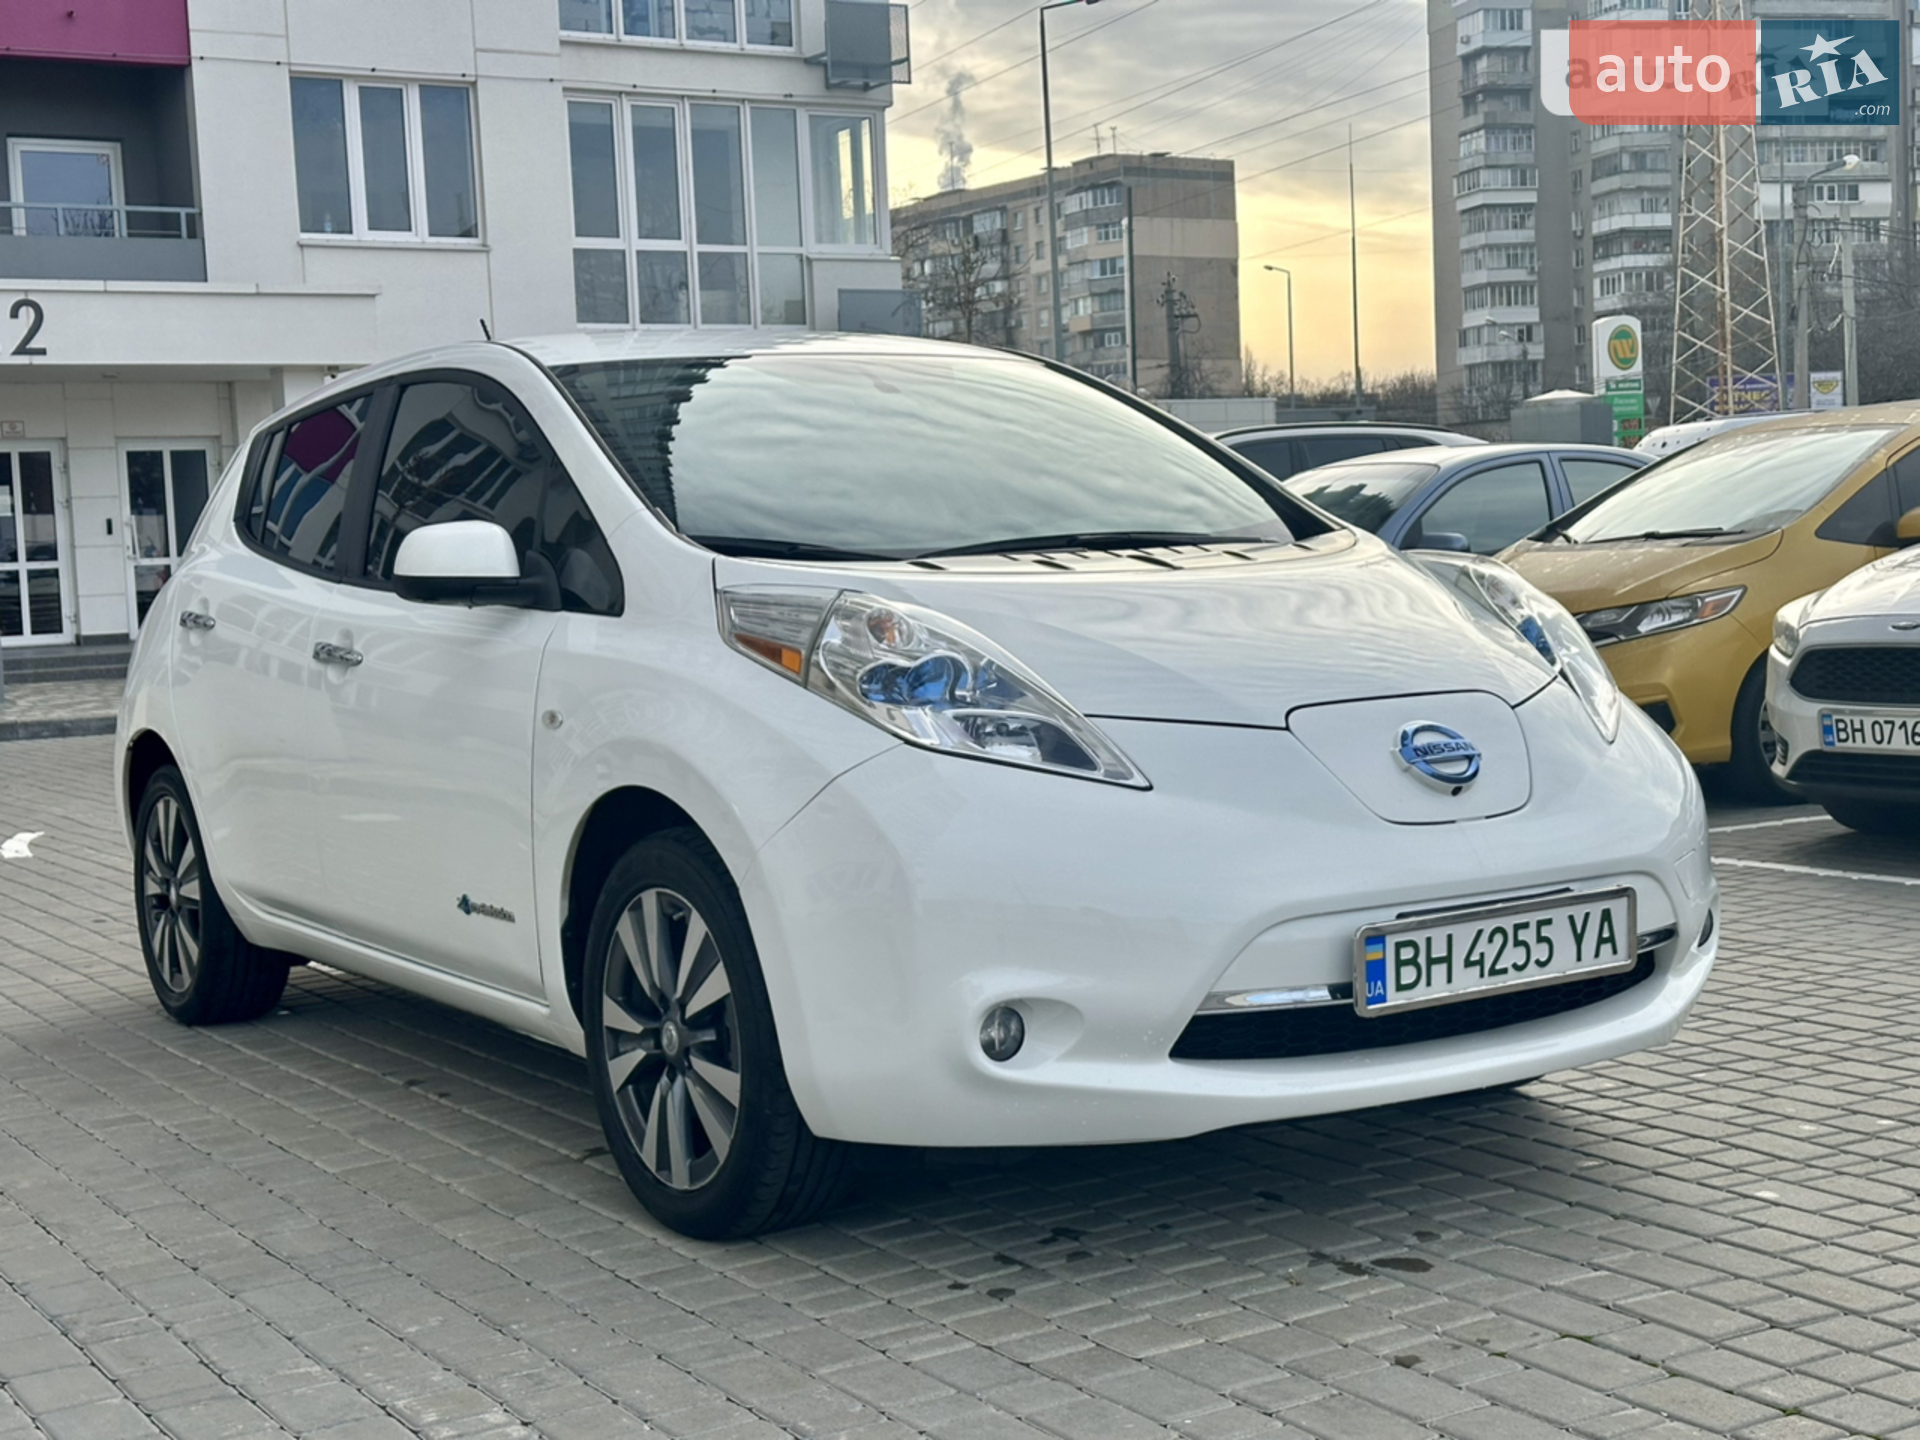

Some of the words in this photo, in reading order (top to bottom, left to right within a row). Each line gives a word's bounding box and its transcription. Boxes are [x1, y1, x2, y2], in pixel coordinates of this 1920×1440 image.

[9, 298, 47, 356] 2
[1834, 718, 1866, 744] BH
[1871, 720, 1920, 746] 0716
[1412, 741, 1477, 758] NISSAN
[1394, 932, 1453, 993] BH
[1463, 917, 1555, 979] 4255
[1567, 907, 1618, 962] YA
[1365, 979, 1385, 998] UA
